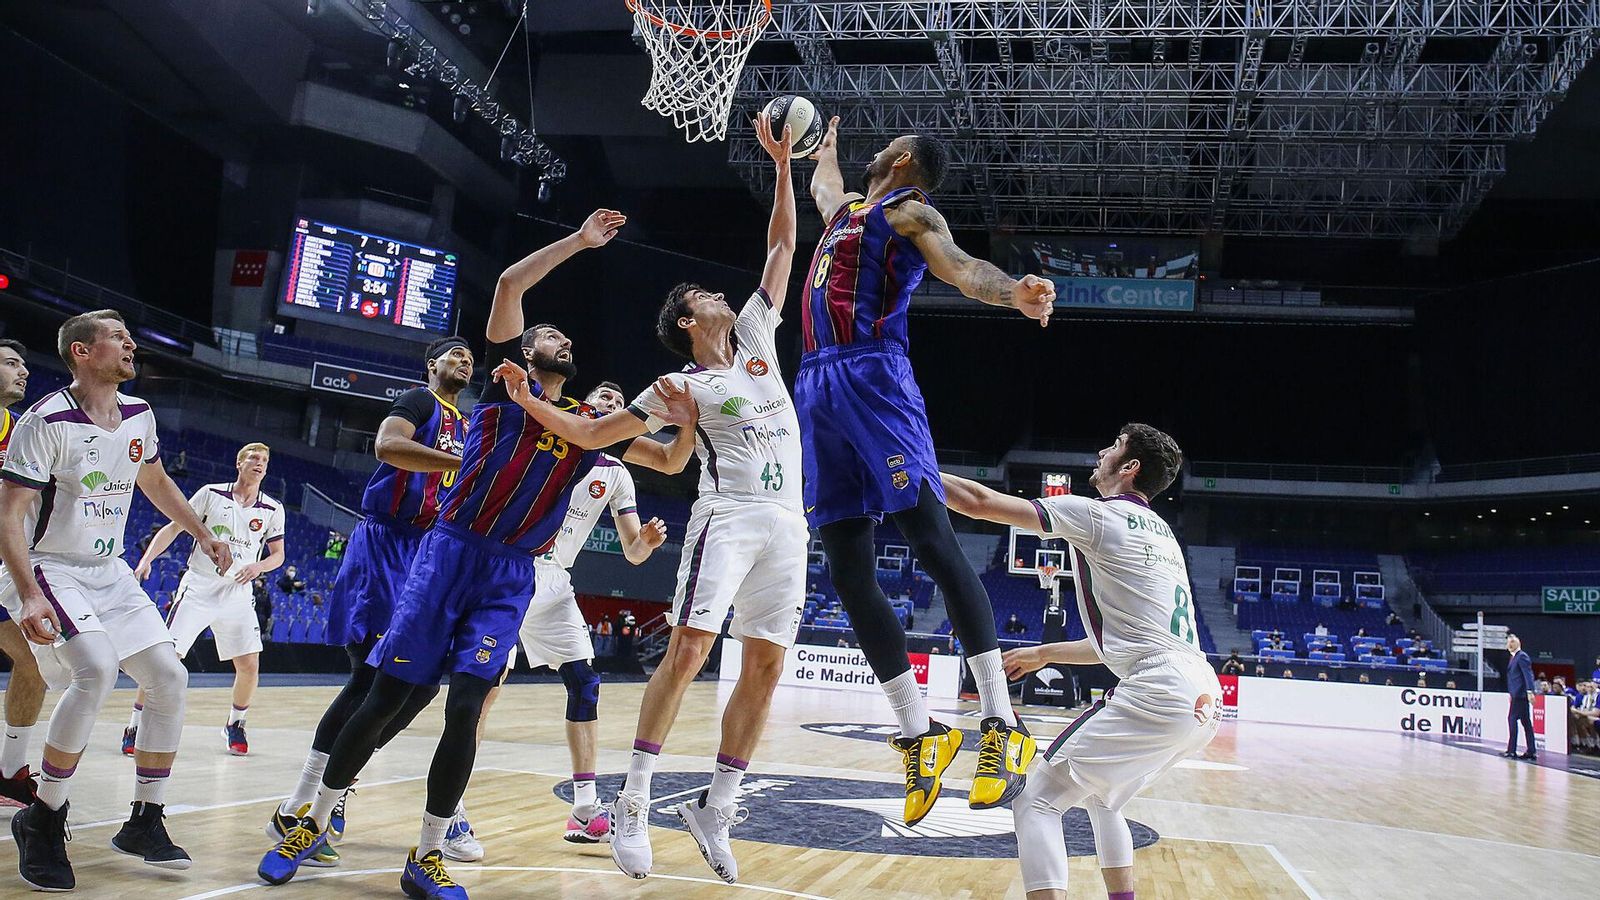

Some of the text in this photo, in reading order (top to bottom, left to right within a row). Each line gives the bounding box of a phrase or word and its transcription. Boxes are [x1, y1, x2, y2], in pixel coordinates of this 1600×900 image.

[361, 235, 369, 247] 7
[386, 242, 400, 255] 21
[814, 253, 830, 289] 8
[362, 278, 388, 296] 3:54
[1057, 280, 1189, 307] ZinkCenter
[350, 297, 359, 309] 2
[322, 374, 351, 389] acb
[753, 396, 788, 415] Unicaja
[742, 423, 791, 443] Málaga
[103, 479, 132, 492] Unicja
[760, 461, 784, 492] 43
[590, 528, 620, 543] LID
[584, 540, 610, 551] EXIT
[1546, 588, 1600, 602] SALID
[1170, 584, 1194, 645] 8
[1565, 602, 1595, 612] EXIT
[796, 649, 868, 667] Comunida
[795, 666, 815, 680] de
[819, 667, 875, 686] Madrid
[1400, 688, 1483, 711] Comunidad
[1400, 713, 1432, 732] de
[1442, 715, 1483, 738] Madrid
